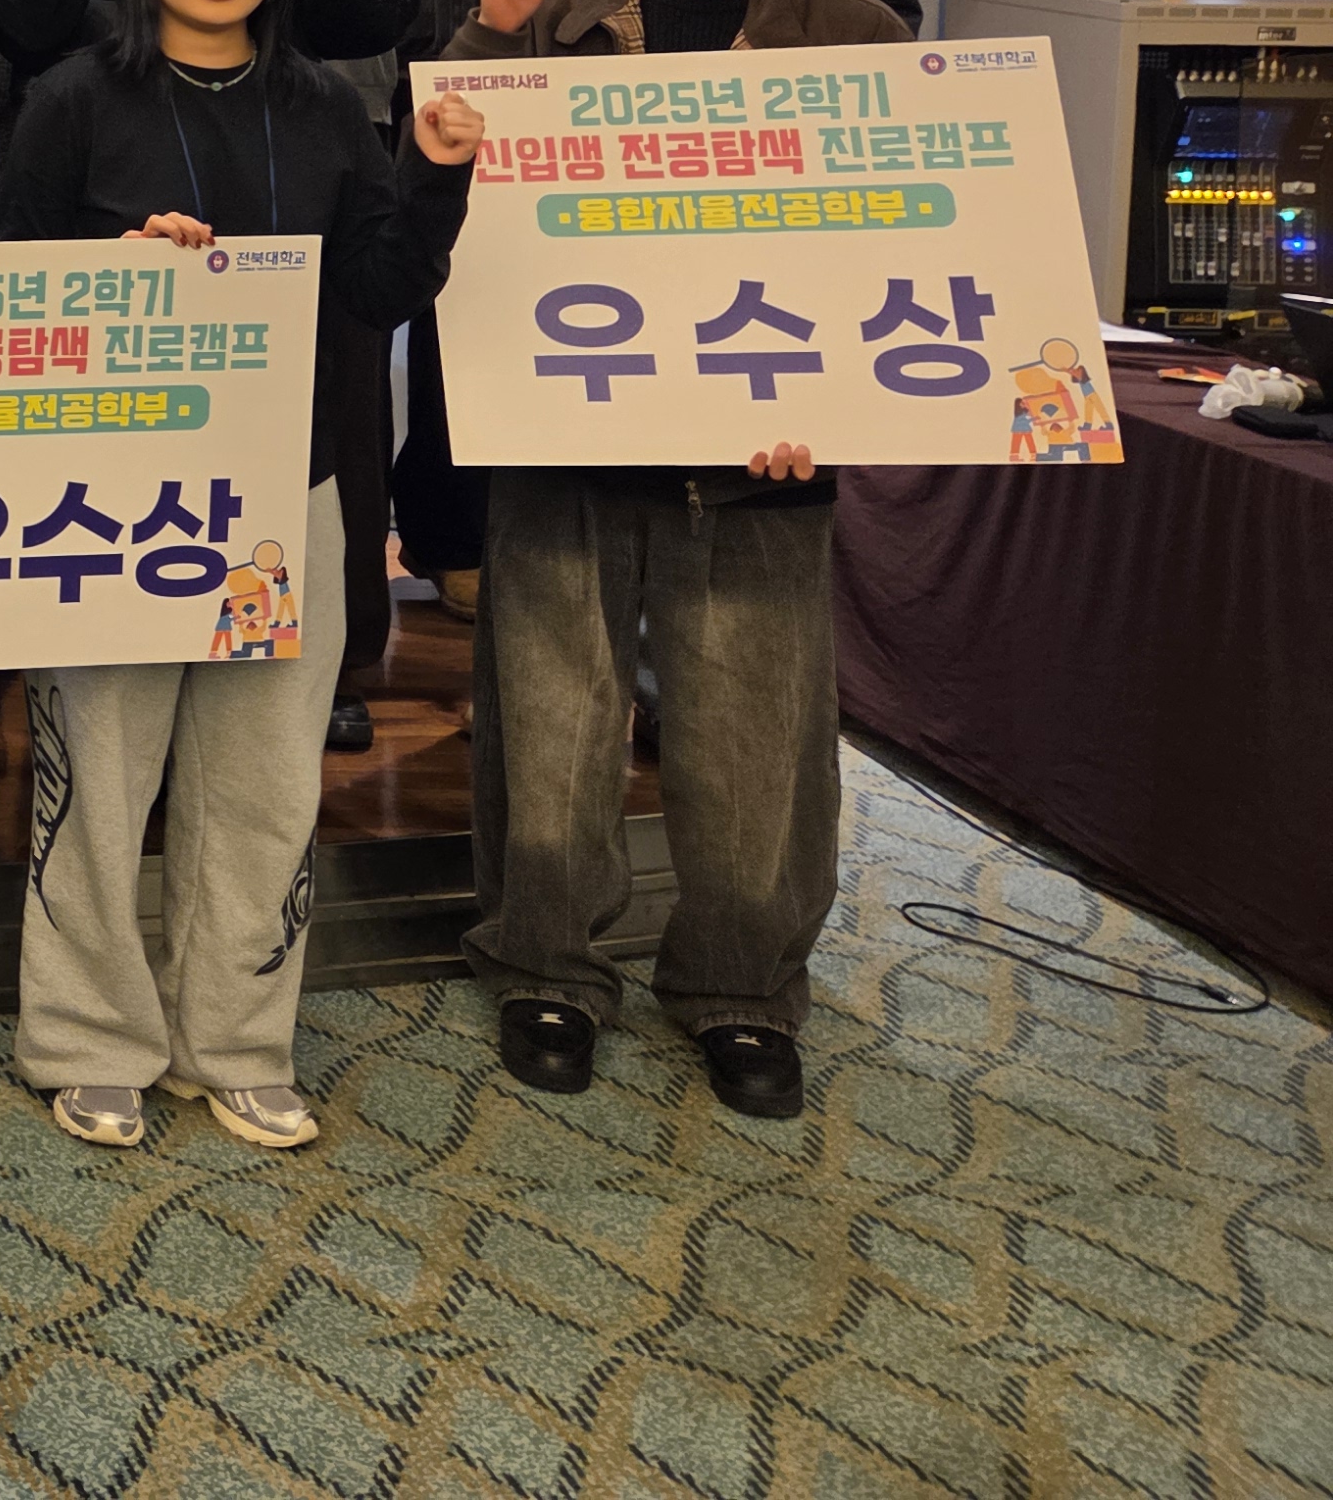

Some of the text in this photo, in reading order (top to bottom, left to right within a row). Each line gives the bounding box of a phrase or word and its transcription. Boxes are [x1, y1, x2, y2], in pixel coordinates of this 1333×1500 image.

[953, 51, 1037, 67] 전북대학교
[433, 74, 548, 92] 글로컬대학사업
[569, 72, 891, 126] 2025년 2학기
[475, 121, 1014, 183] 신입생 전공탐색 진로캠프
[579, 191, 904, 231] 융합자율전공학부
[236, 250, 306, 266] 전북대학교
[62, 269, 174, 317] 2학기
[105, 324, 268, 373] 진로캠프
